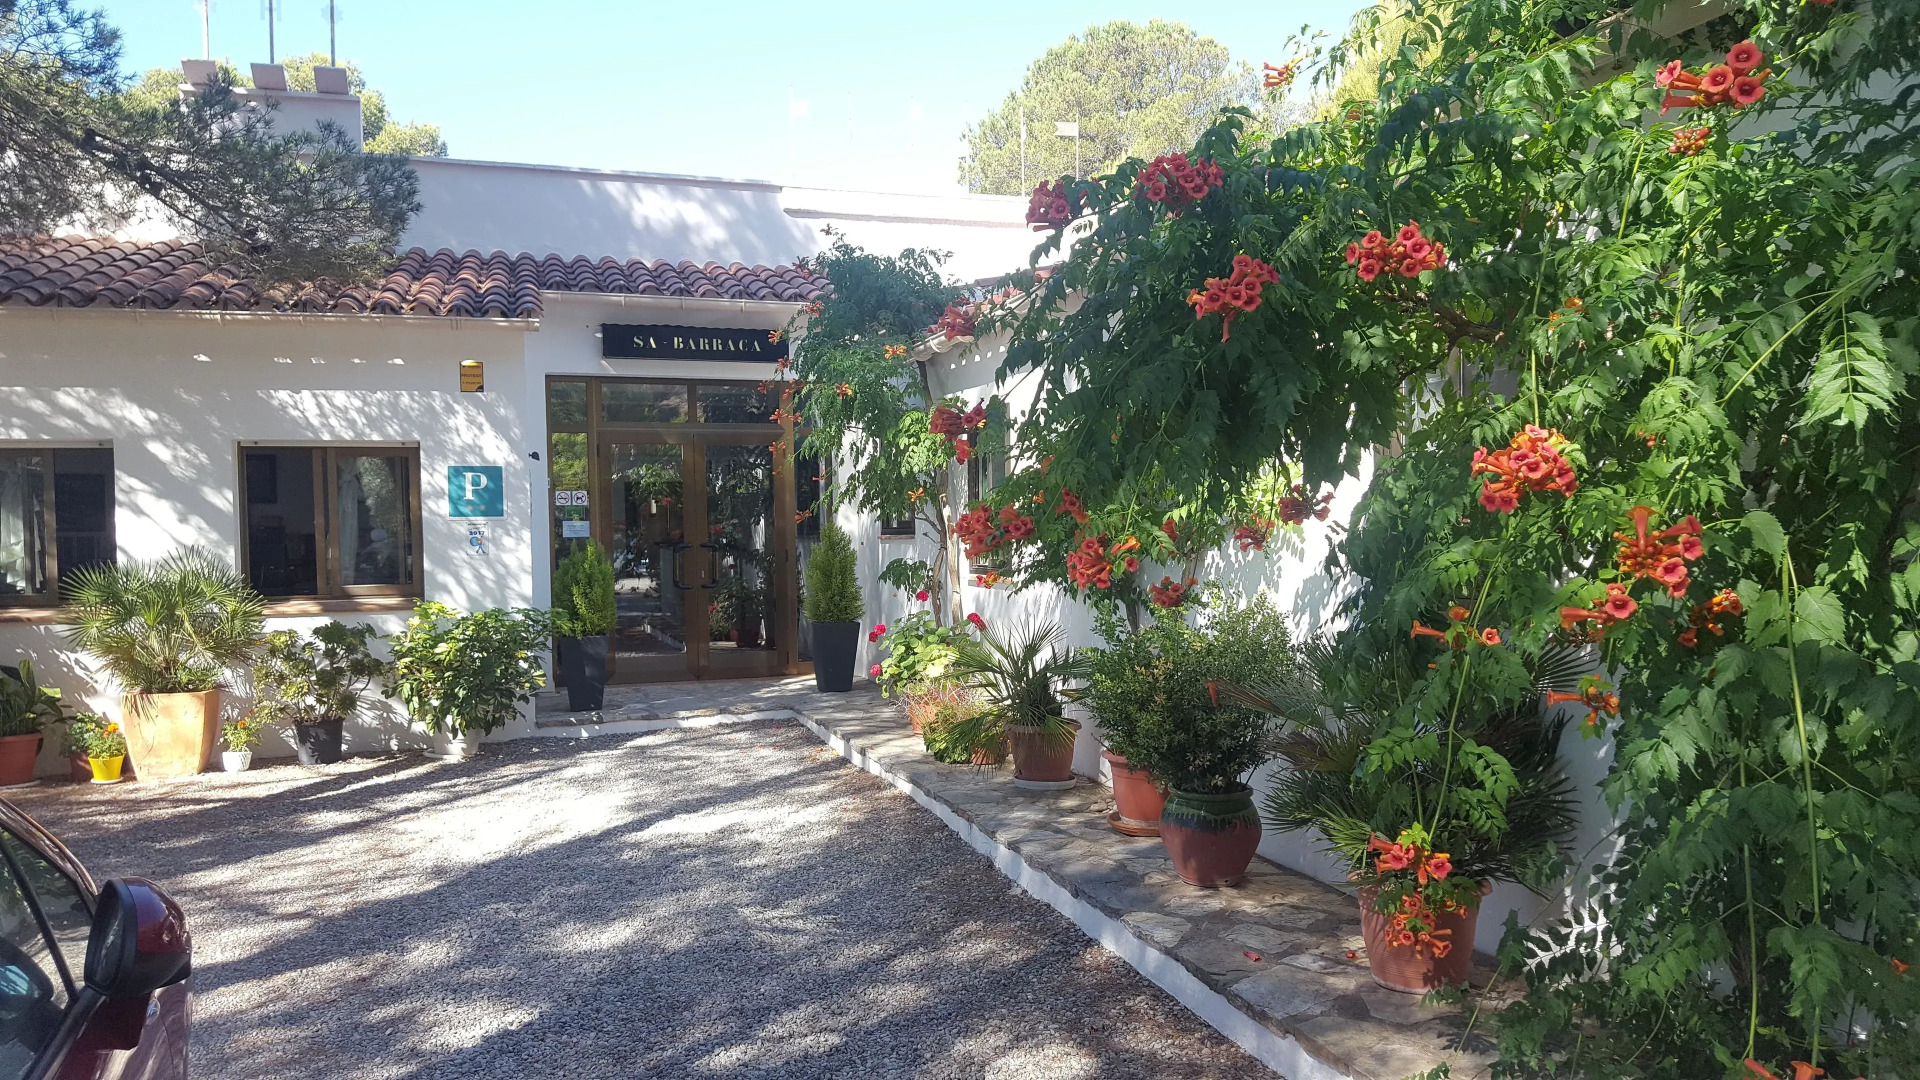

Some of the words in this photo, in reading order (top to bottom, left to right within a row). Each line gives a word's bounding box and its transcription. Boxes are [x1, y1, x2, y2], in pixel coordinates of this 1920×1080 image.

[633, 335, 657, 349] SA
[673, 336, 761, 352] BARRACA
[462, 472, 488, 500] P
